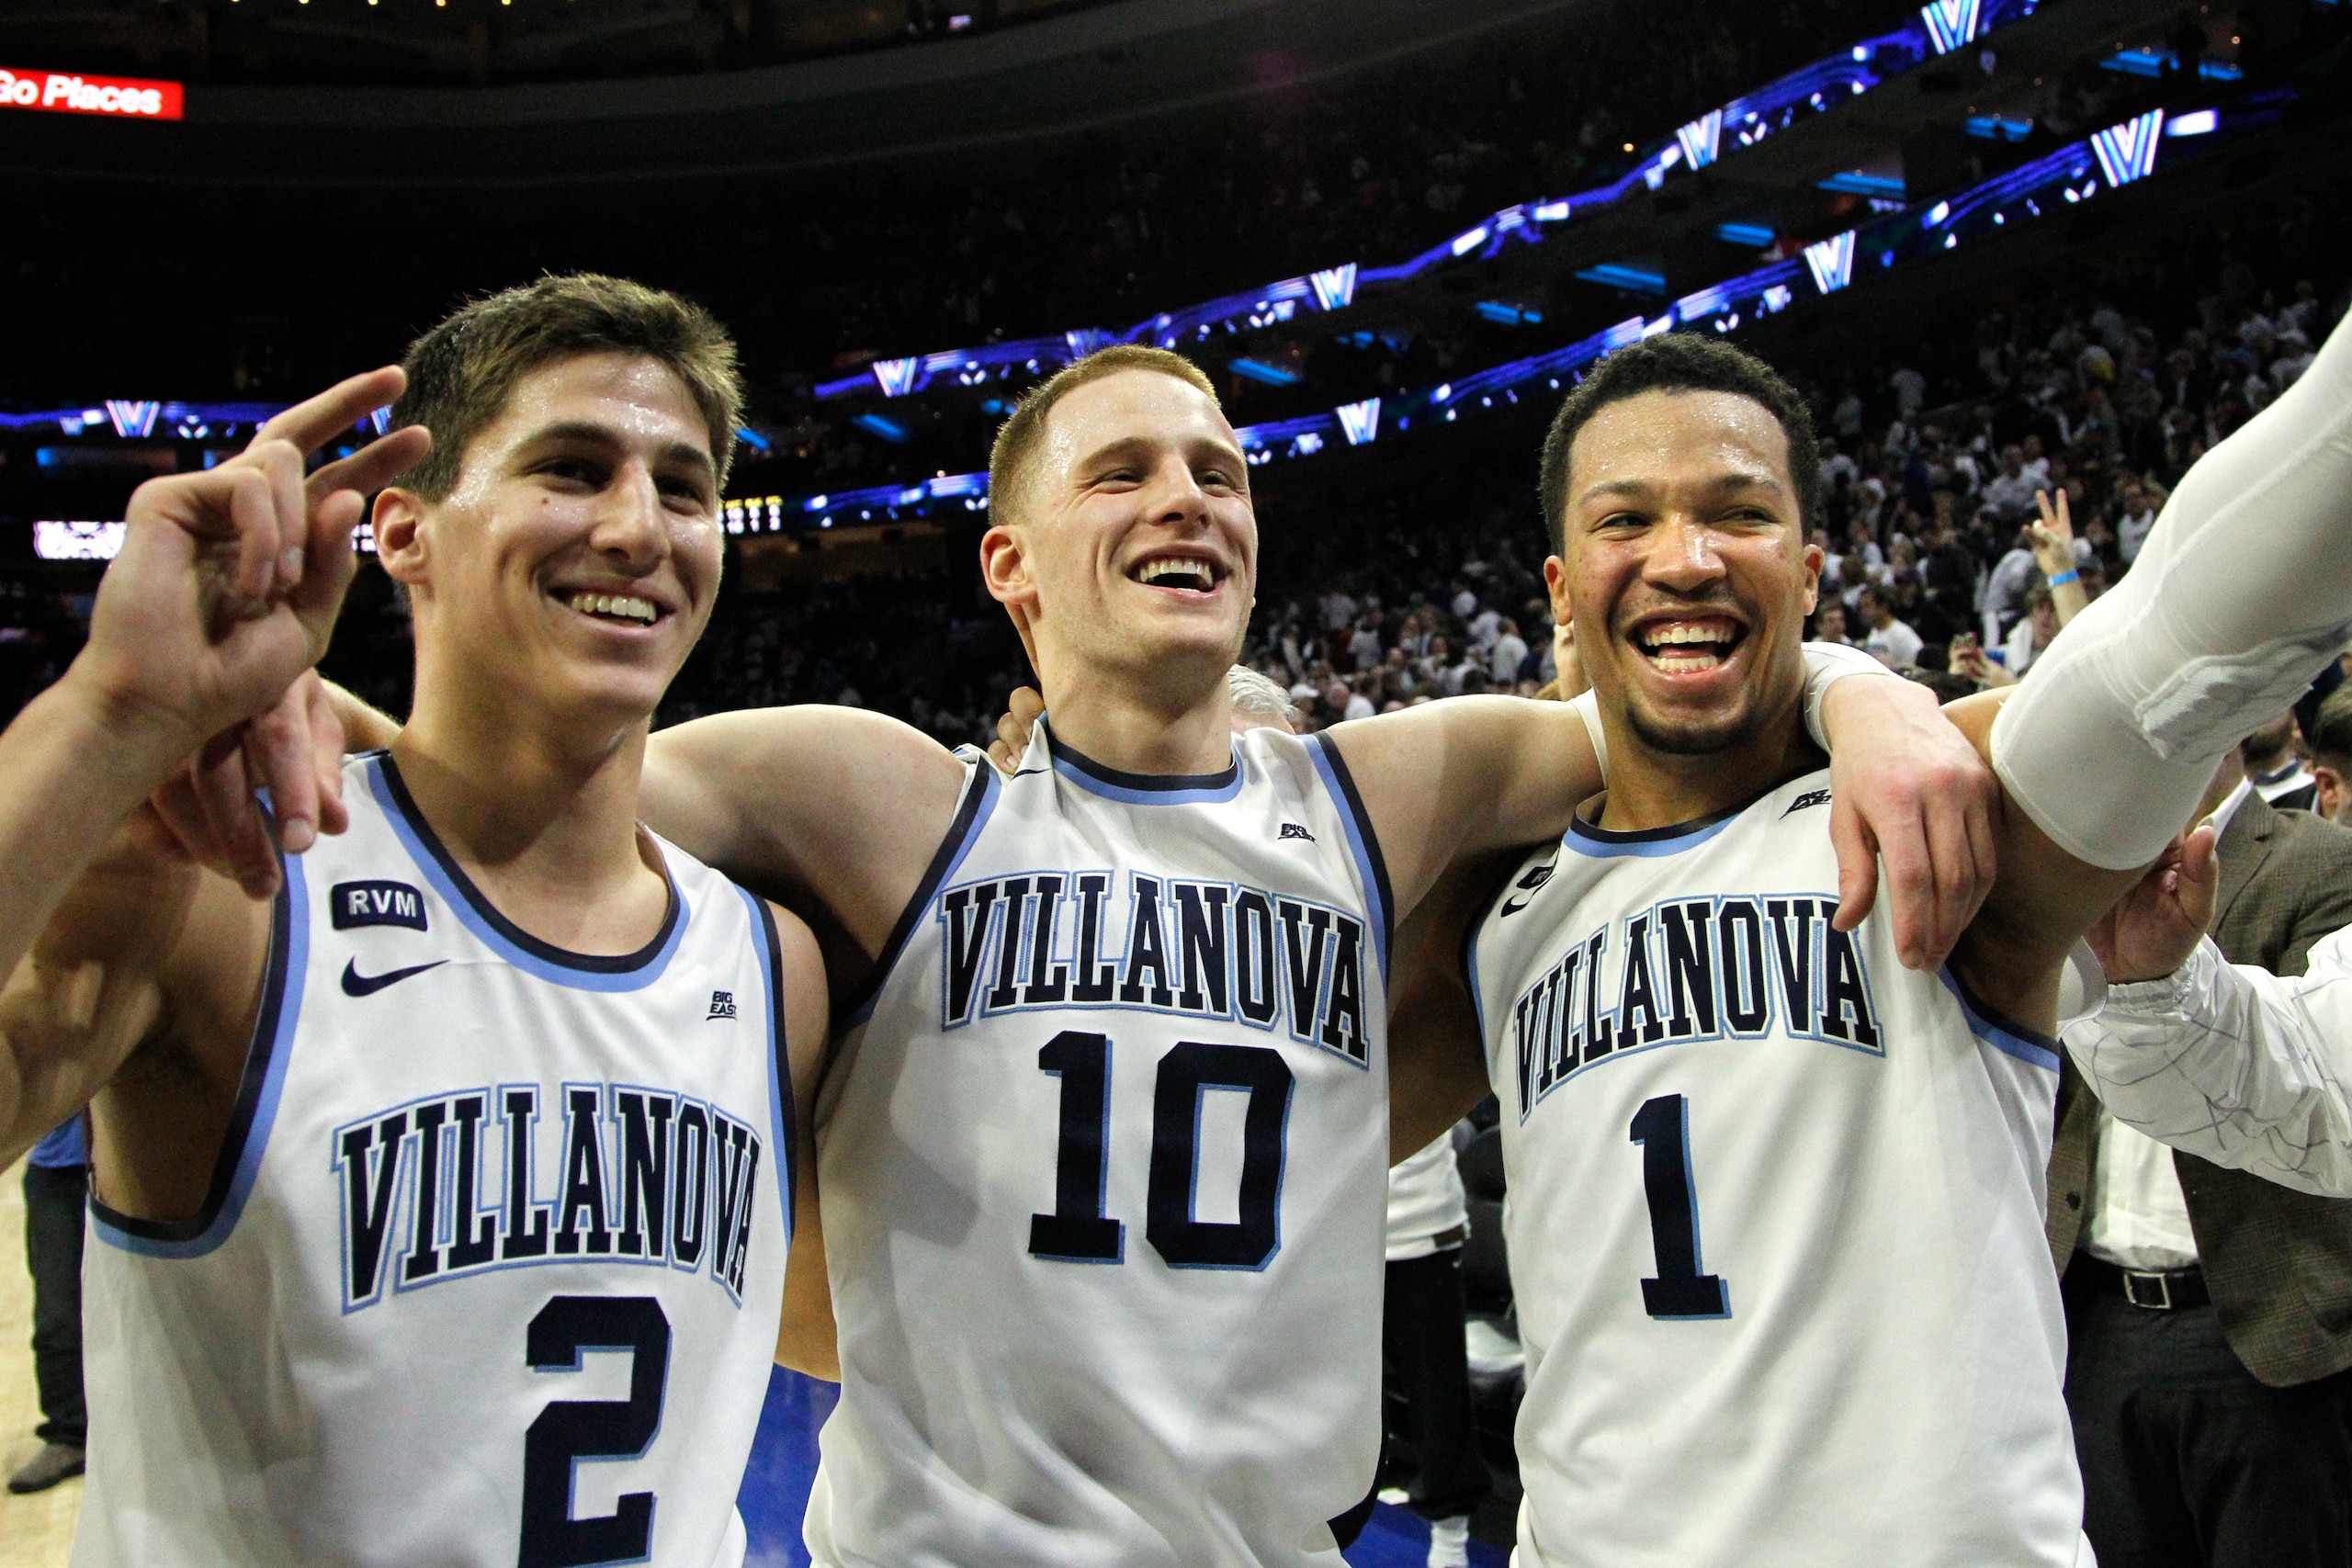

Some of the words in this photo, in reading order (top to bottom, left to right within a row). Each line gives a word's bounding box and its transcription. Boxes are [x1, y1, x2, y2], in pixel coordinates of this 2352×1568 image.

[42, 74, 163, 114] Places
[347, 889, 417, 918] RVM
[712, 991, 732, 1003] BIG
[937, 869, 1370, 1071] VILLANOVA
[1512, 892, 1886, 1127] VILLANOVA
[330, 1082, 763, 1316] VILLANOVA
[1028, 1031, 1296, 1272] 10
[1630, 1093, 1733, 1321] 1
[516, 1296, 673, 1568] 2
